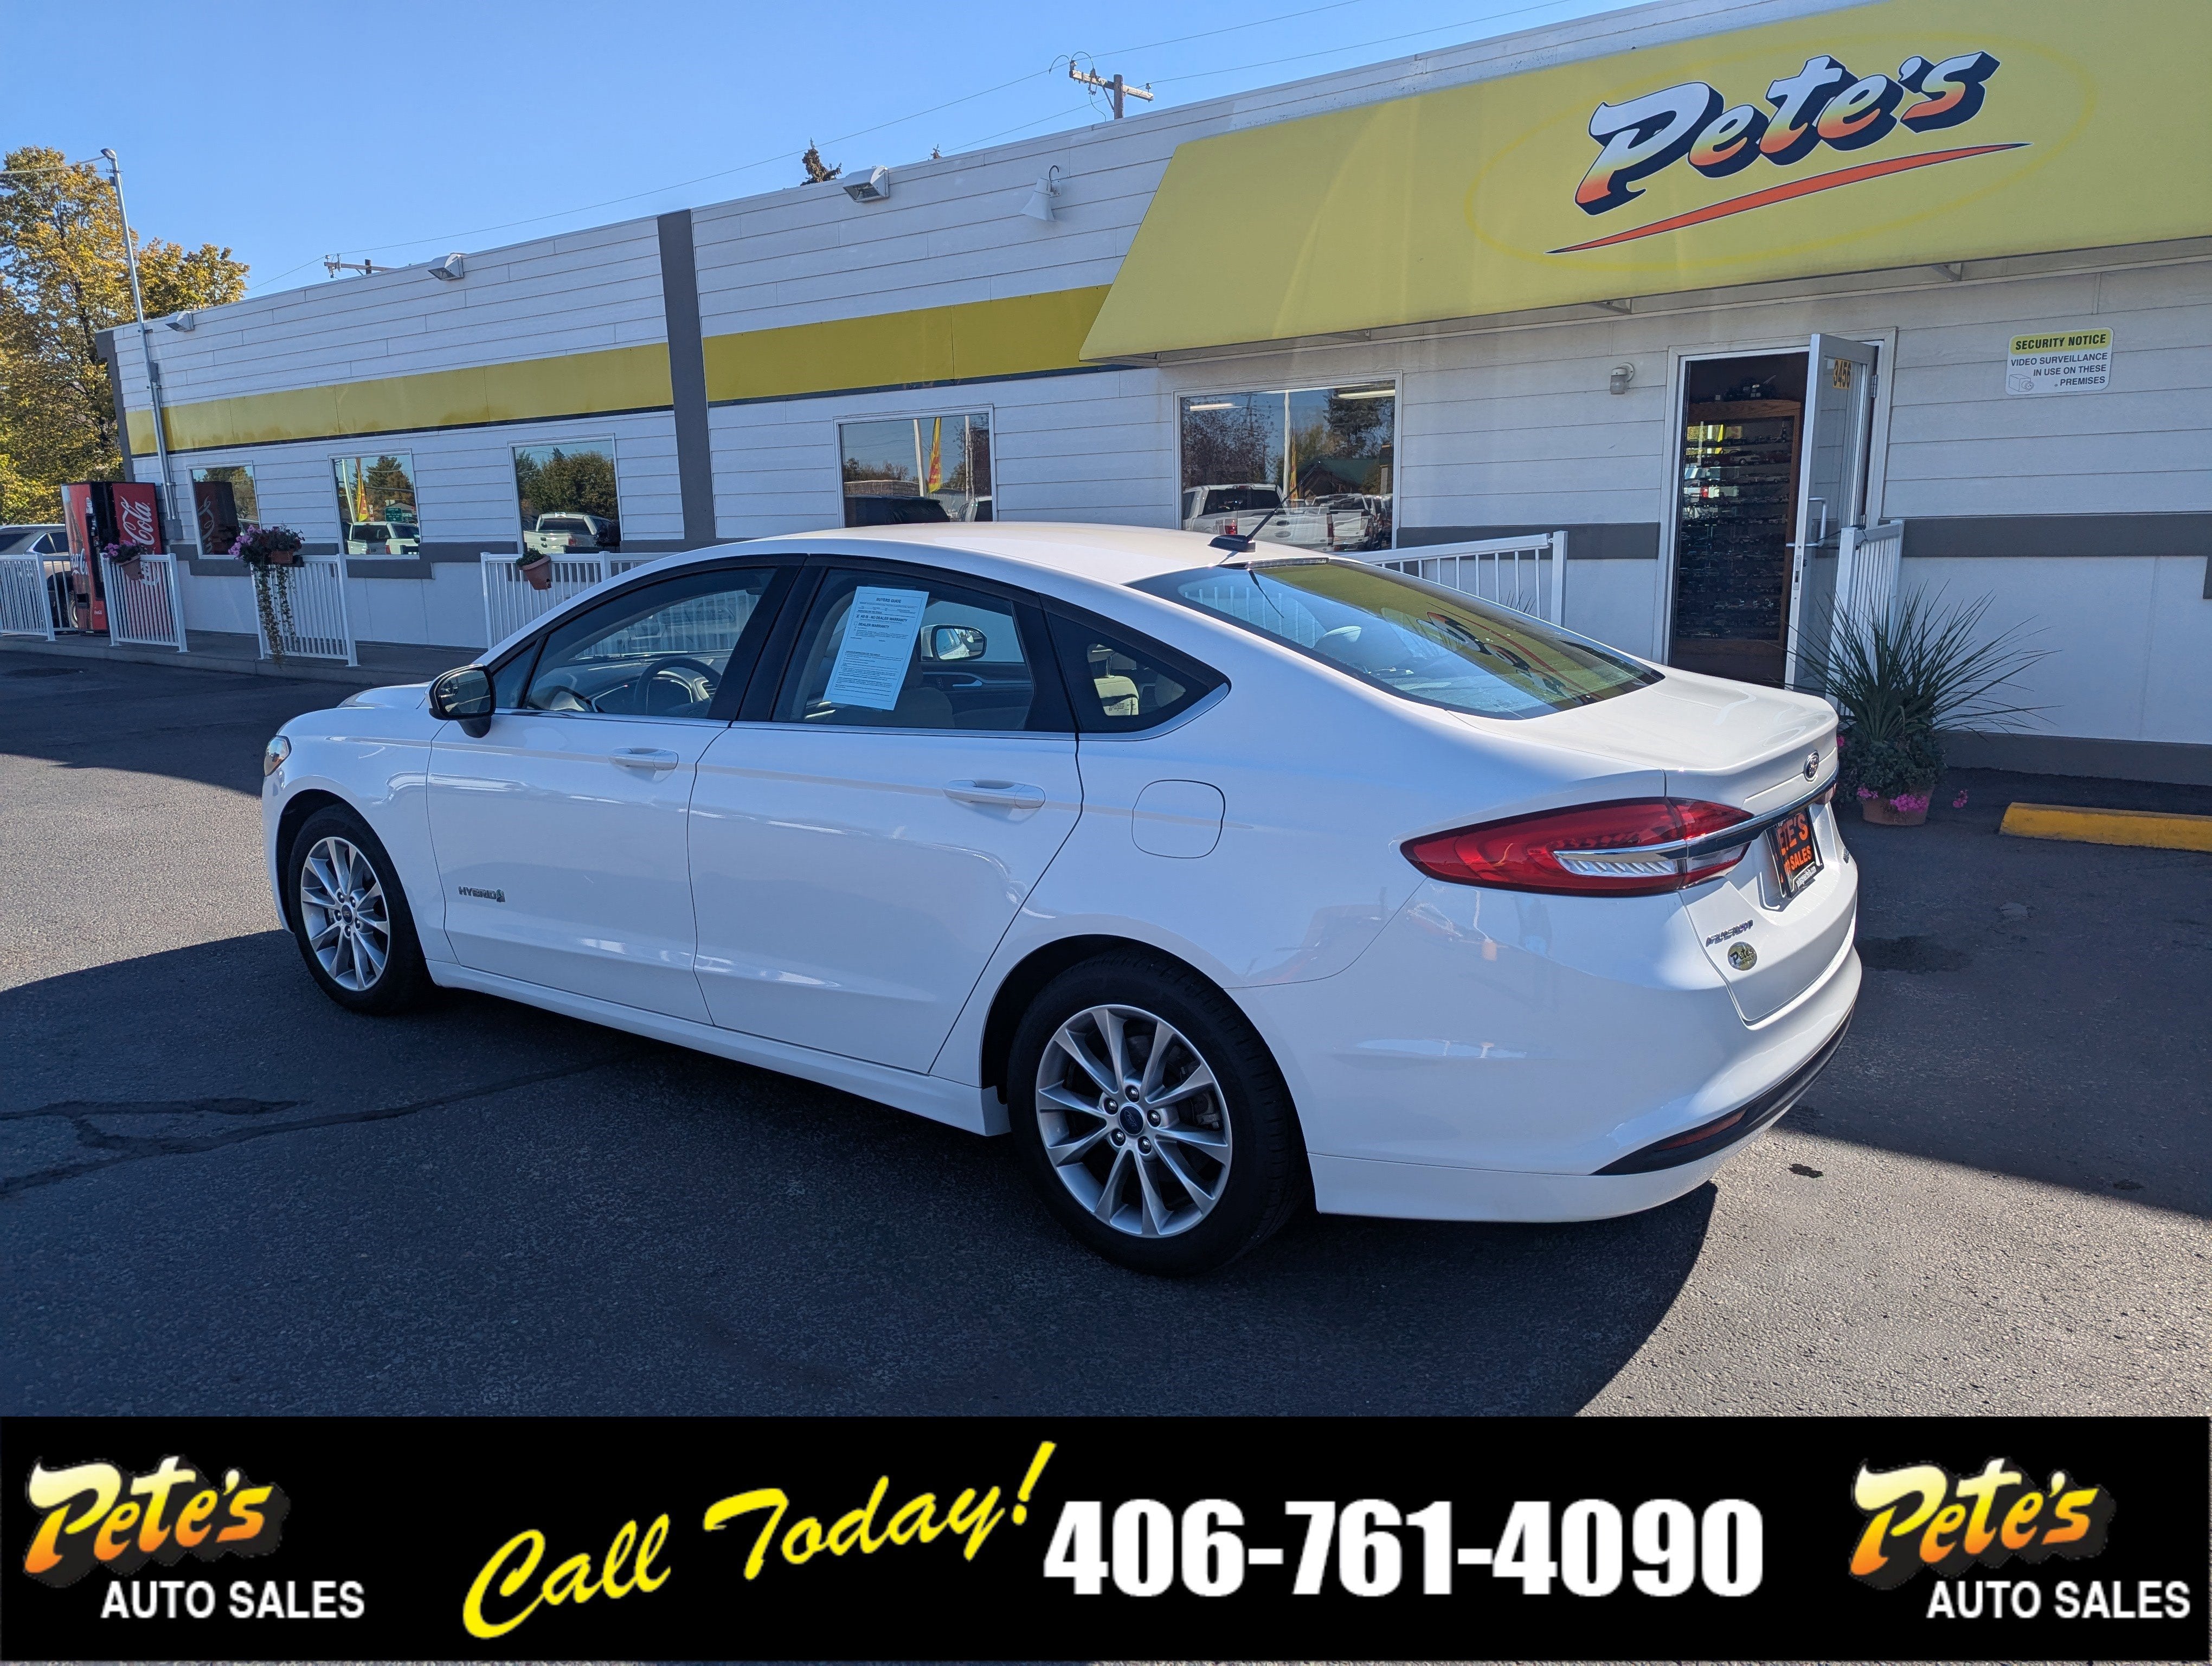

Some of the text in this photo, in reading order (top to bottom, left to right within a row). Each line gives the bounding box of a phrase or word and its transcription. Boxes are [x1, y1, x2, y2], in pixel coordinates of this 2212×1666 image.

[1574, 50, 2002, 216] Pete's
[2015, 334, 2106, 350] SECURITY NOTICE
[2011, 353, 2108, 366] VIDEO SURVEILLANCE
[1833, 360, 1851, 389] 3456
[2033, 364, 2107, 376] IN USE ON THESE
[2060, 376, 2106, 386] PREMISES
[1790, 845, 1812, 870] SALES
[458, 886, 497, 900] HYBRID
[1729, 948, 1754, 965] Pete's
